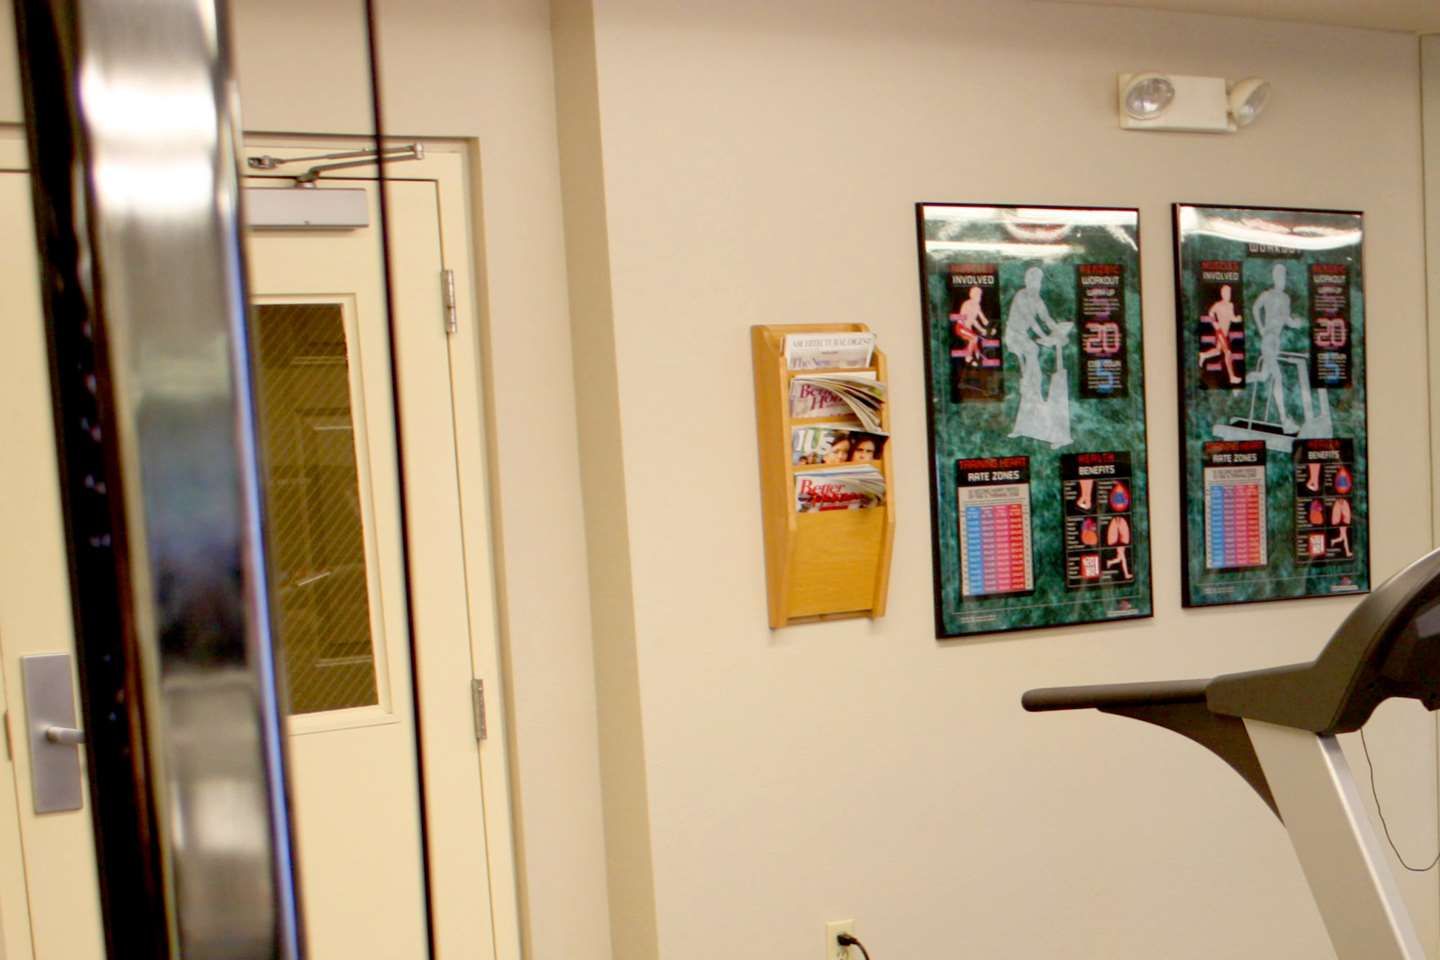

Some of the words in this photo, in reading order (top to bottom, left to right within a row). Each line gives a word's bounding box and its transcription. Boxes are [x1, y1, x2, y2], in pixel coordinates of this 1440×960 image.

[952, 275, 995, 286] INVOLVED
[1081, 276, 1120, 285] WORKOUT
[1084, 322, 1121, 354] 20
[1314, 317, 1347, 348] 20
[968, 472, 990, 482] RATE
[991, 470, 1020, 481] ZONES
[1078, 465, 1116, 476] BENEFITS
